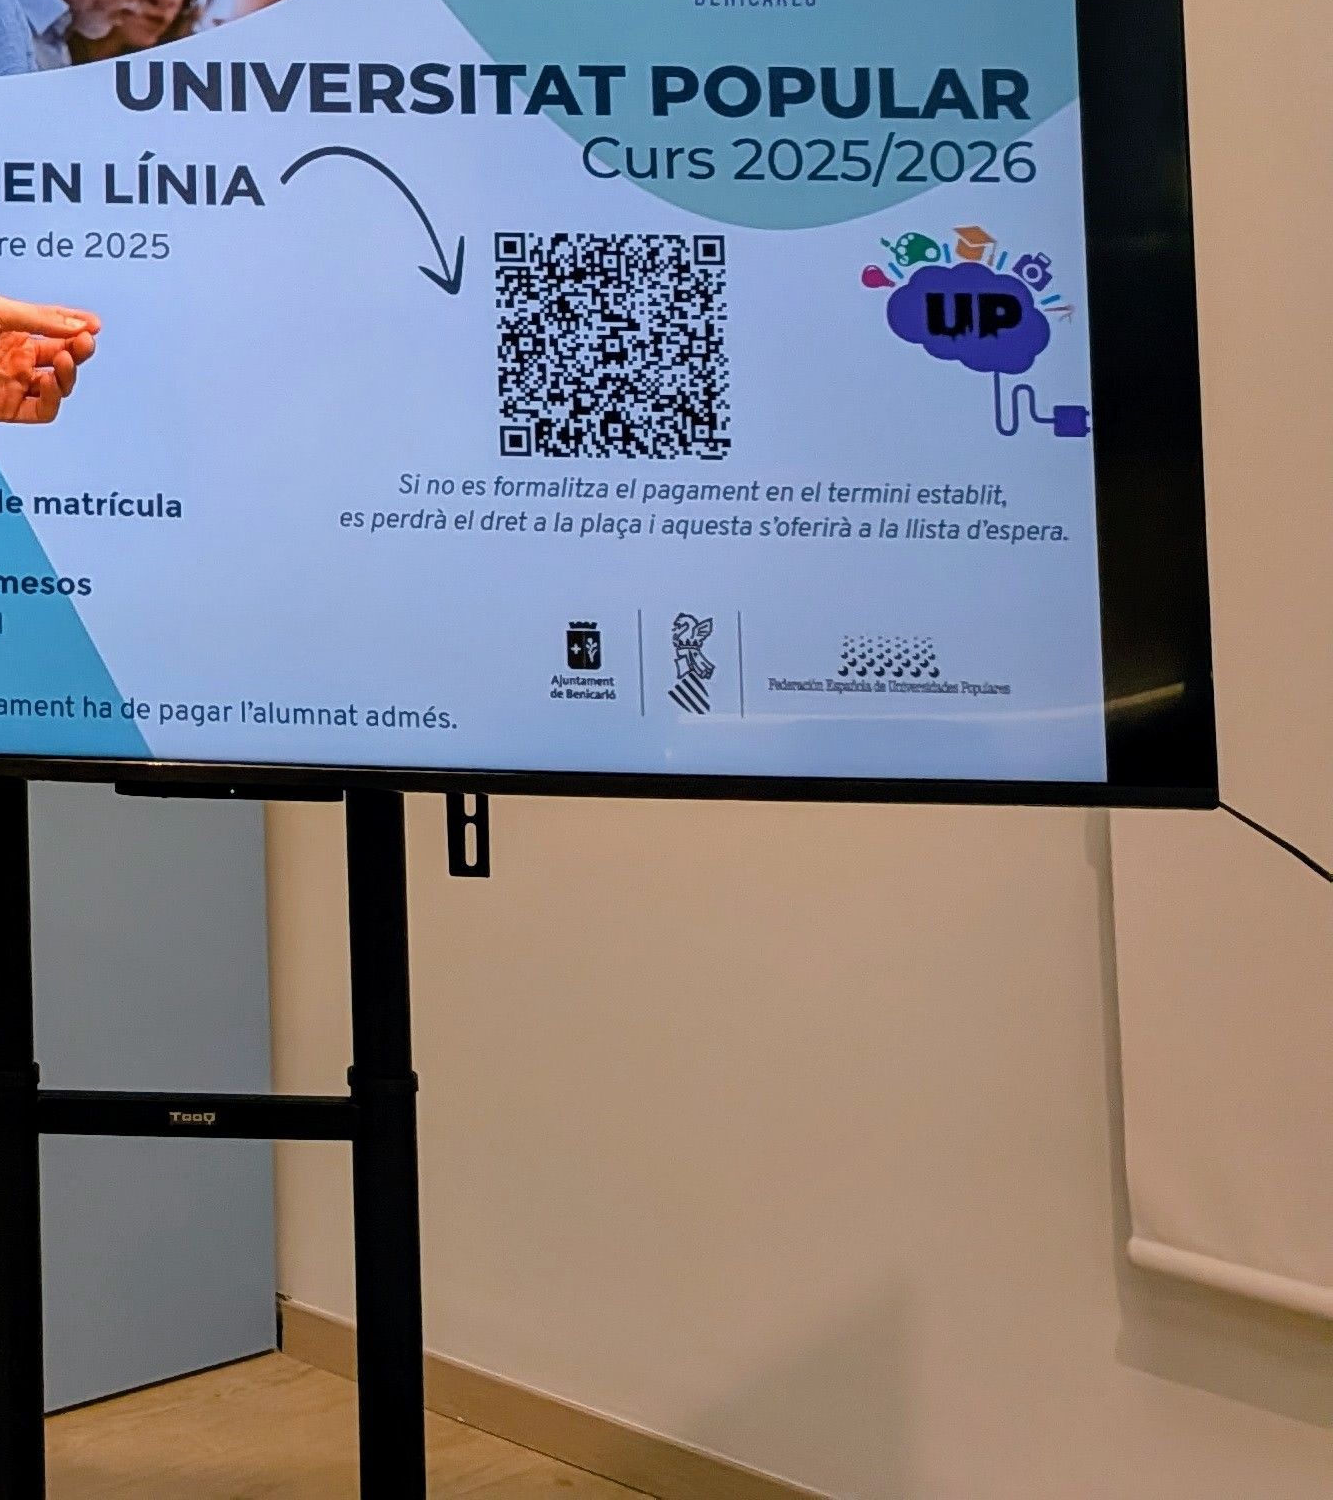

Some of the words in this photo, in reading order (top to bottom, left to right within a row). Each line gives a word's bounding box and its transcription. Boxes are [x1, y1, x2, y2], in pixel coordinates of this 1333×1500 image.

[115, 61, 625, 117] UNIVERSITAT
[653, 65, 1032, 120] POPULAR
[4, 162, 82, 203] EN
[105, 151, 266, 206] LÍNIA
[582, 135, 714, 182] Curs
[733, 136, 1036, 187] 2025/2026
[36, 232, 74, 258] de
[84, 232, 171, 260] 2025
[926, 293, 1022, 340] UP
[33, 491, 182, 518] matrícula
[399, 473, 420, 495] Si
[427, 479, 455, 496] no
[461, 480, 486, 496] es
[493, 475, 609, 499] formalitza
[616, 478, 637, 500] el
[642, 481, 759, 505] pagament
[766, 485, 794, 502] en
[801, 481, 821, 503] el
[828, 482, 910, 504] termini
[917, 484, 1007, 508] establit,
[339, 511, 364, 528] es
[370, 508, 447, 534] perdrà
[454, 509, 475, 530] el
[480, 509, 528, 532] dret
[533, 516, 546, 532] a
[553, 511, 573, 533] la
[579, 512, 642, 539] plaça
[648, 512, 656, 534] i
[661, 515, 753, 541] aquesta
[759, 516, 852, 538] s'oferirà
[858, 521, 871, 538] a
[879, 517, 898, 539] la
[905, 518, 960, 540] llista
[967, 519, 1069, 545] d'espera.
[549, 688, 564, 699] de
[550, 674, 615, 687] Ajuntament
[84, 696, 112, 719] ha
[120, 698, 150, 720] de
[159, 703, 233, 726] pagar
[241, 700, 358, 727] l'alumnat
[366, 705, 458, 729] admés.
